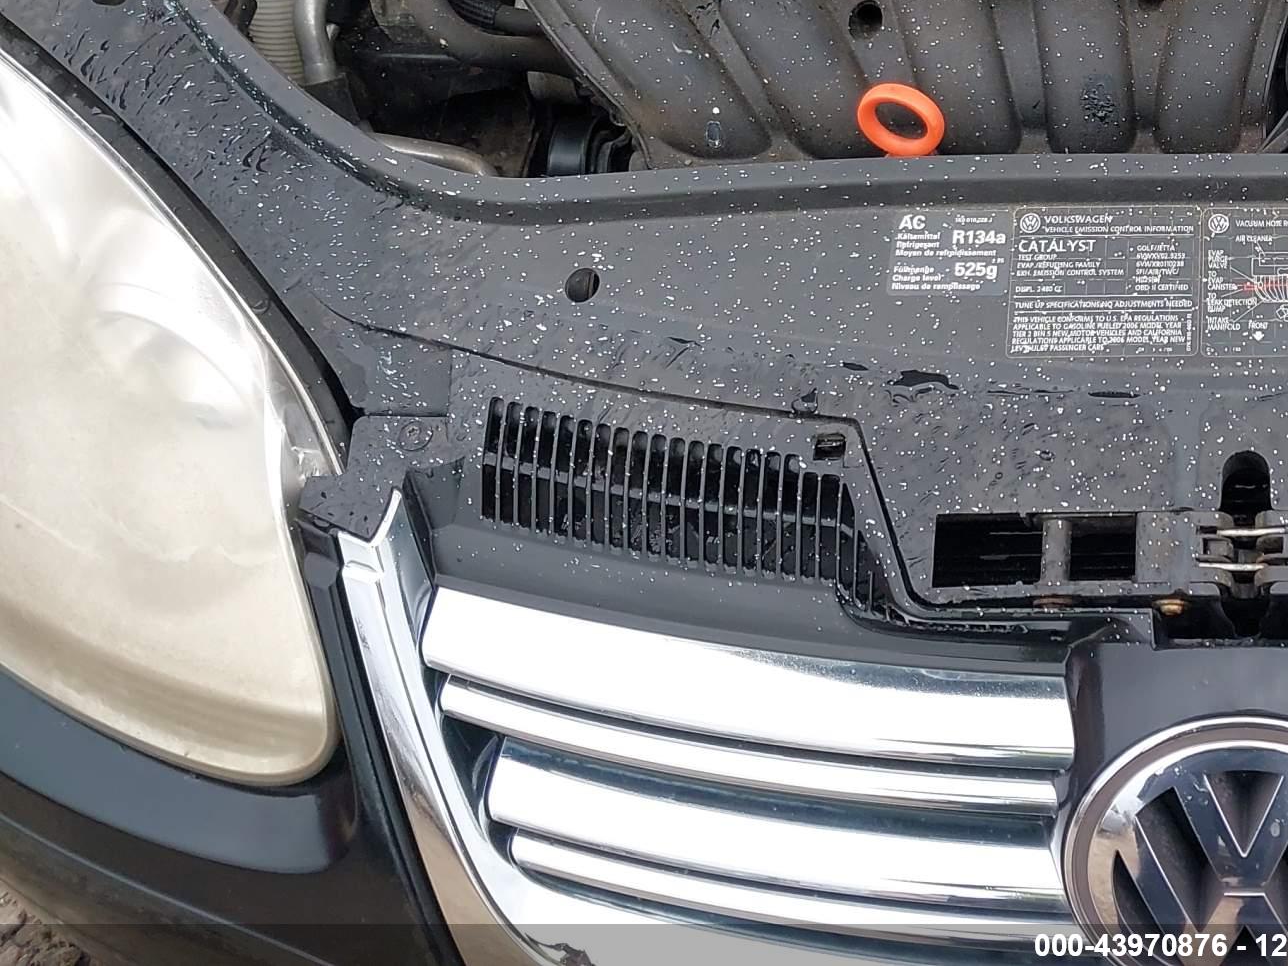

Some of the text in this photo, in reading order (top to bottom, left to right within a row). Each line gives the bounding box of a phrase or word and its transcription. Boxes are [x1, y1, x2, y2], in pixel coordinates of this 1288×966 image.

[899, 214, 926, 230] AC
[1044, 215, 1114, 224] VOLKSWAGEN
[952, 230, 1006, 244] R134a
[1019, 240, 1096, 252] CATALYST
[895, 250, 922, 258] Moyen
[955, 262, 998, 280] 525g
[892, 274, 941, 282] Charge level
[933, 282, 980, 291] remplissage
[1114, 300, 1164, 308] ADJUSTMENTS
[1166, 300, 1192, 308] NEEDED
[1224, 298, 1258, 306] DETECTION
[1134, 314, 1178, 322] REGULATIONS
[1248, 322, 1268, 330] FRONT
[1098, 336, 1107, 344] TO
[1050, 344, 1086, 352] PASSENGER
[1088, 344, 1104, 352] CARS
